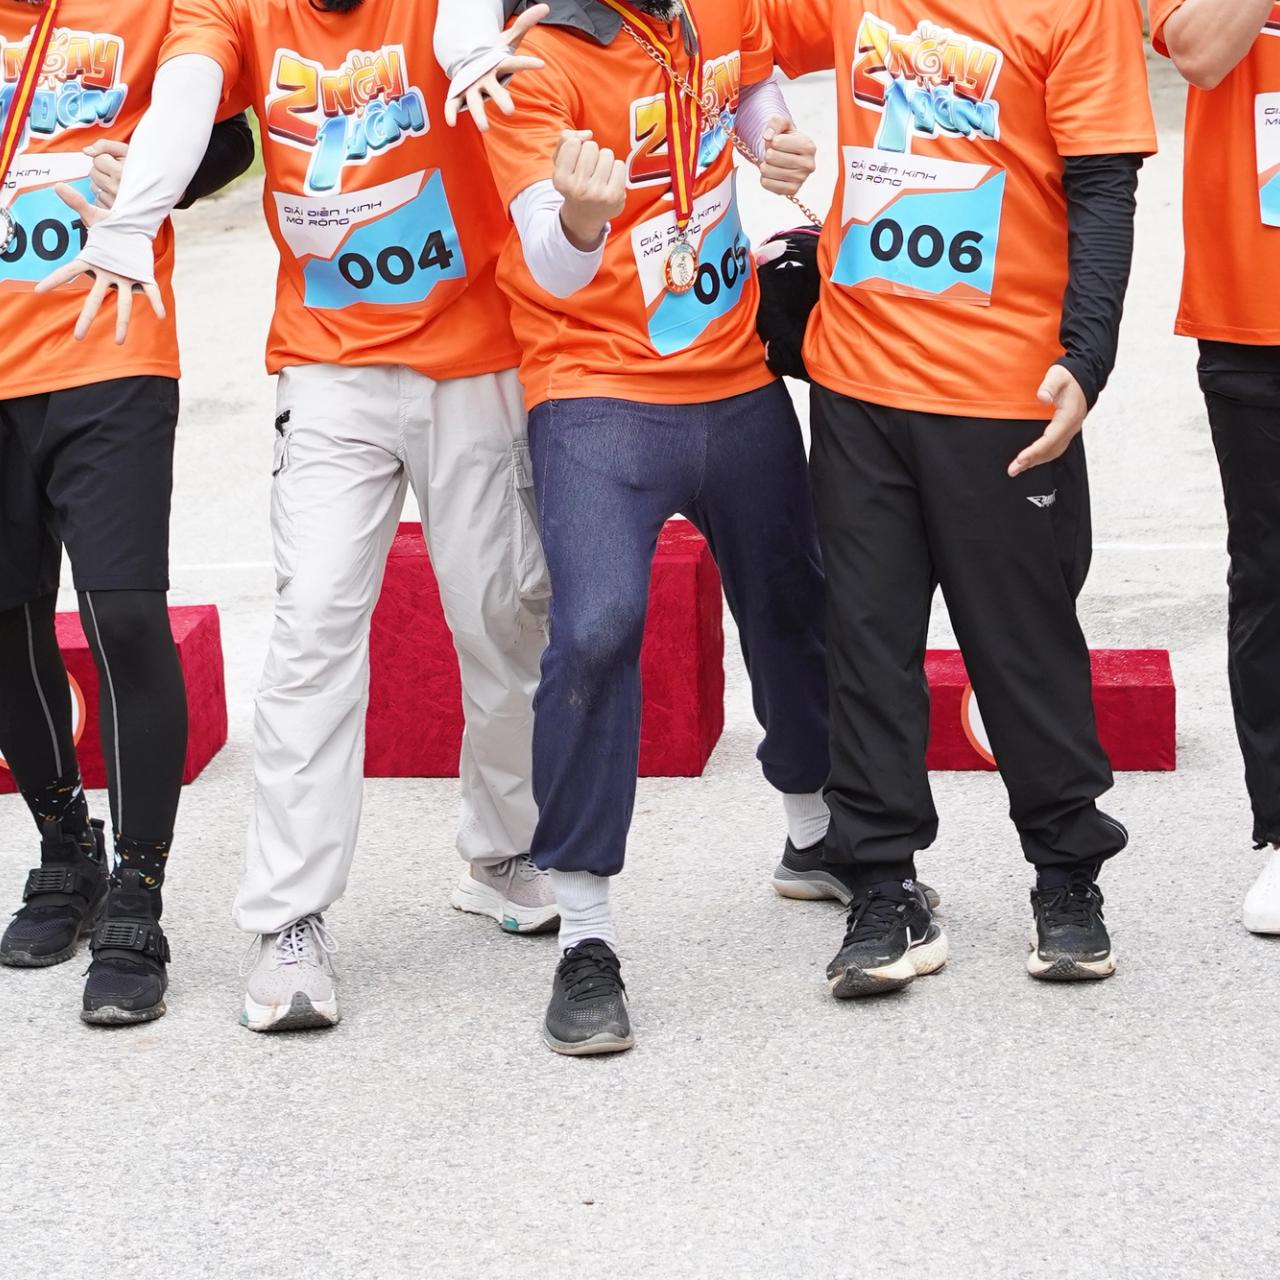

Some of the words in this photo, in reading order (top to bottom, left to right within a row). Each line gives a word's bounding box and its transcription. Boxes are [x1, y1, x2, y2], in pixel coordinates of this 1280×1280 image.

[267, 54, 319, 147] 2
[877, 79, 911, 153] 1
[309, 115, 348, 192] 1
[337, 229, 454, 290] 004
[870, 217, 985, 274] 006
